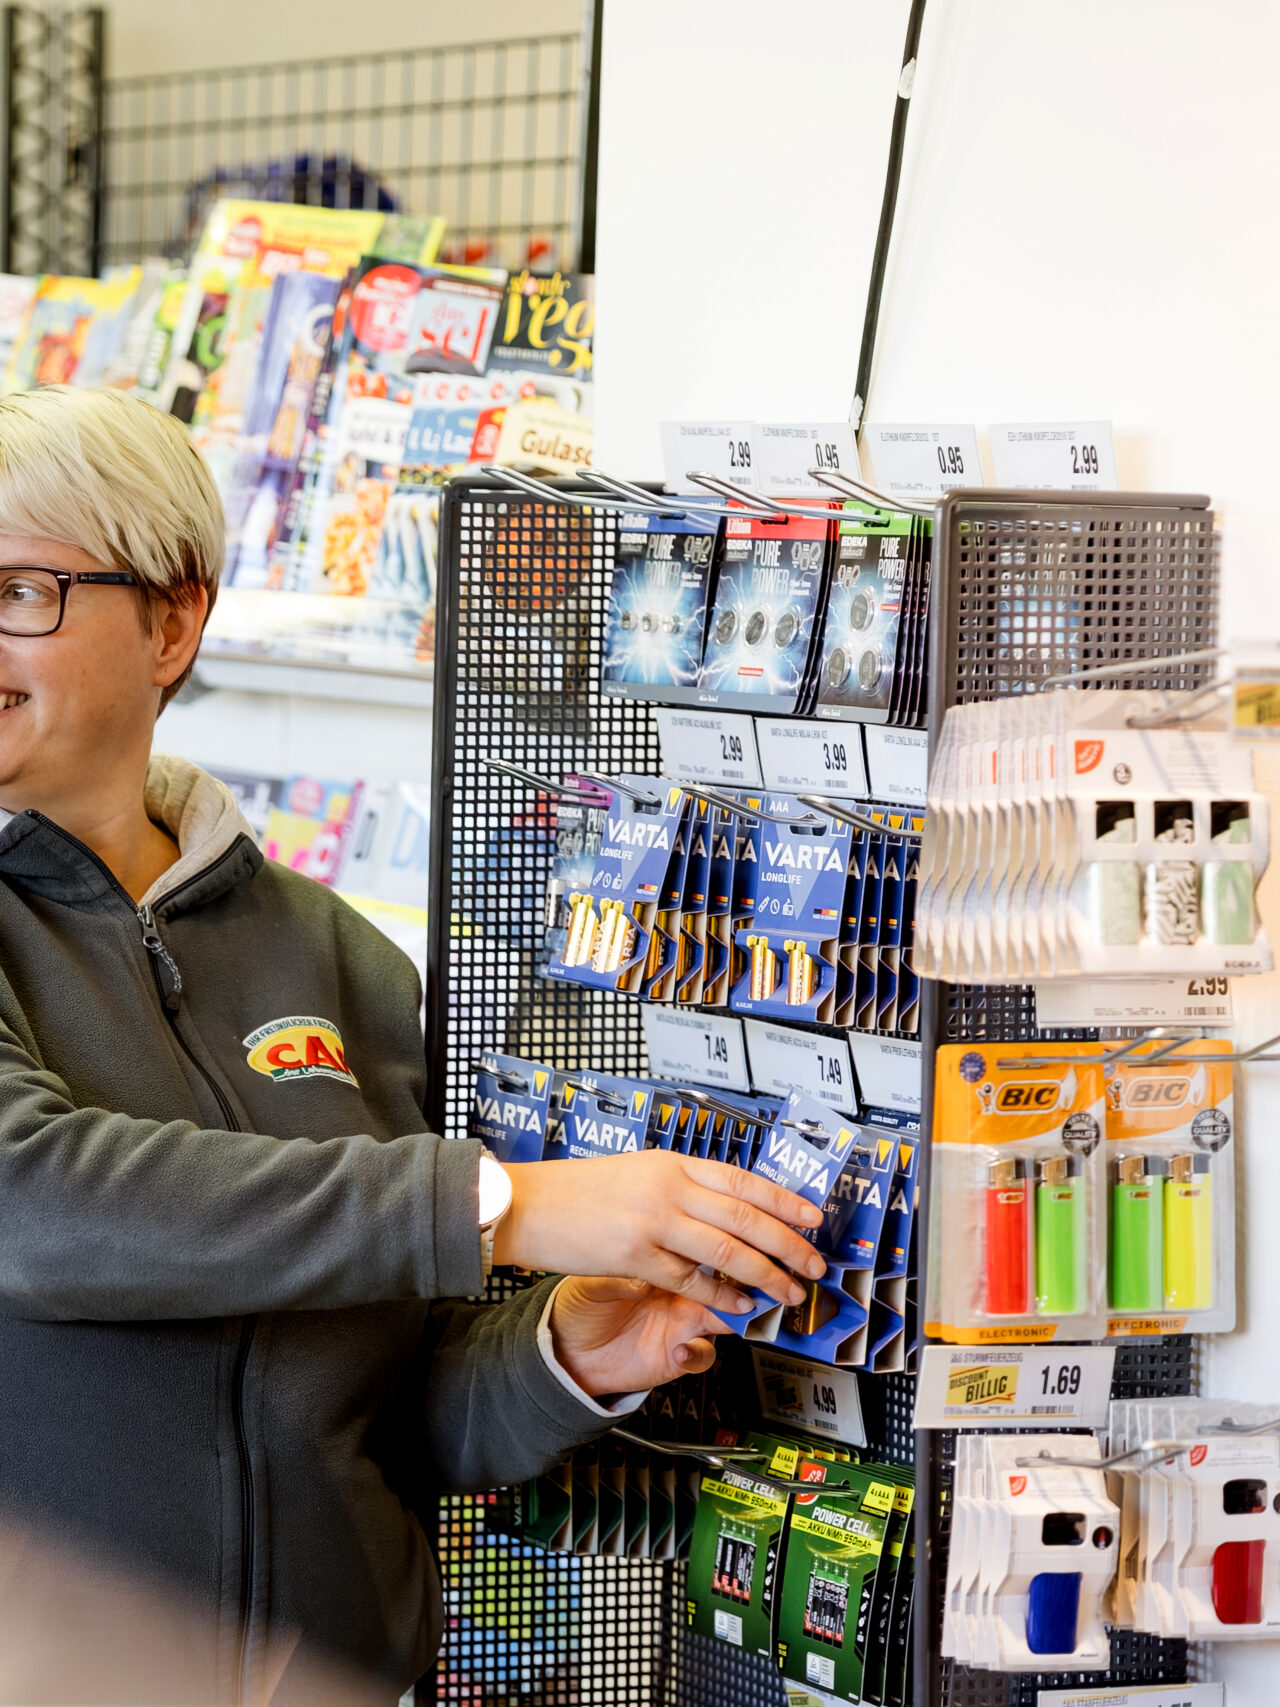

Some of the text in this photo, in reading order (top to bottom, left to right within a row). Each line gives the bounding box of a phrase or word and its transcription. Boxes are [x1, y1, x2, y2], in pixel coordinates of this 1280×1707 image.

[729, 441, 751, 467] 2.99
[816, 444, 839, 470] 0.95
[938, 446, 964, 473] 0.95
[1071, 445, 1099, 474] 2.99
[647, 534, 677, 560] PURE
[726, 539, 782, 567] EDEKA PURE
[841, 535, 900, 558] EDEKA PURE
[751, 568, 790, 594] POWER
[877, 559, 905, 579] POWER
[720, 734, 743, 761] 2.99
[823, 743, 847, 770] 3.99
[557, 806, 583, 818] EDEKA
[769, 800, 789, 813] AAA
[608, 818, 669, 850] VARTA
[600, 847, 634, 860] LONGLIFE
[765, 841, 843, 873] VARTA
[761, 872, 802, 884] LONGLIFE
[736, 1001, 752, 1009] ALKALINE
[247, 1035, 262, 1047] IHR
[261, 1019, 312, 1037] FREUNDLICHER
[705, 1034, 728, 1062] 7.49
[817, 1055, 842, 1085] 7.49
[476, 1094, 542, 1135] VARTA
[472, 1124, 508, 1141] LONGLIFE
[574, 1115, 638, 1152] VARTA
[1064, 1130, 1096, 1139] QUALITY
[1193, 1127, 1228, 1135] QUALITY
[756, 1159, 790, 1188] LONGLIFE
[768, 1131, 829, 1195] VARTA
[979, 1327, 1049, 1339] ELECTRONIC
[1109, 1319, 1180, 1331] ELECTRONIC
[949, 1370, 989, 1390] DISCOUNT
[965, 1376, 1008, 1403] BILLIG
[1041, 1365, 1081, 1395] 1.69
[812, 1383, 837, 1415] 4.99
[717, 1485, 734, 1496] AKKU
[750, 1495, 778, 1511] 950mAh
[721, 1471, 776, 1499] POWER CELL
[812, 1506, 847, 1529] POWER
[846, 1517, 870, 1536] CELL
[807, 1522, 825, 1535] AKKU
[843, 1534, 872, 1550] 950mAh
